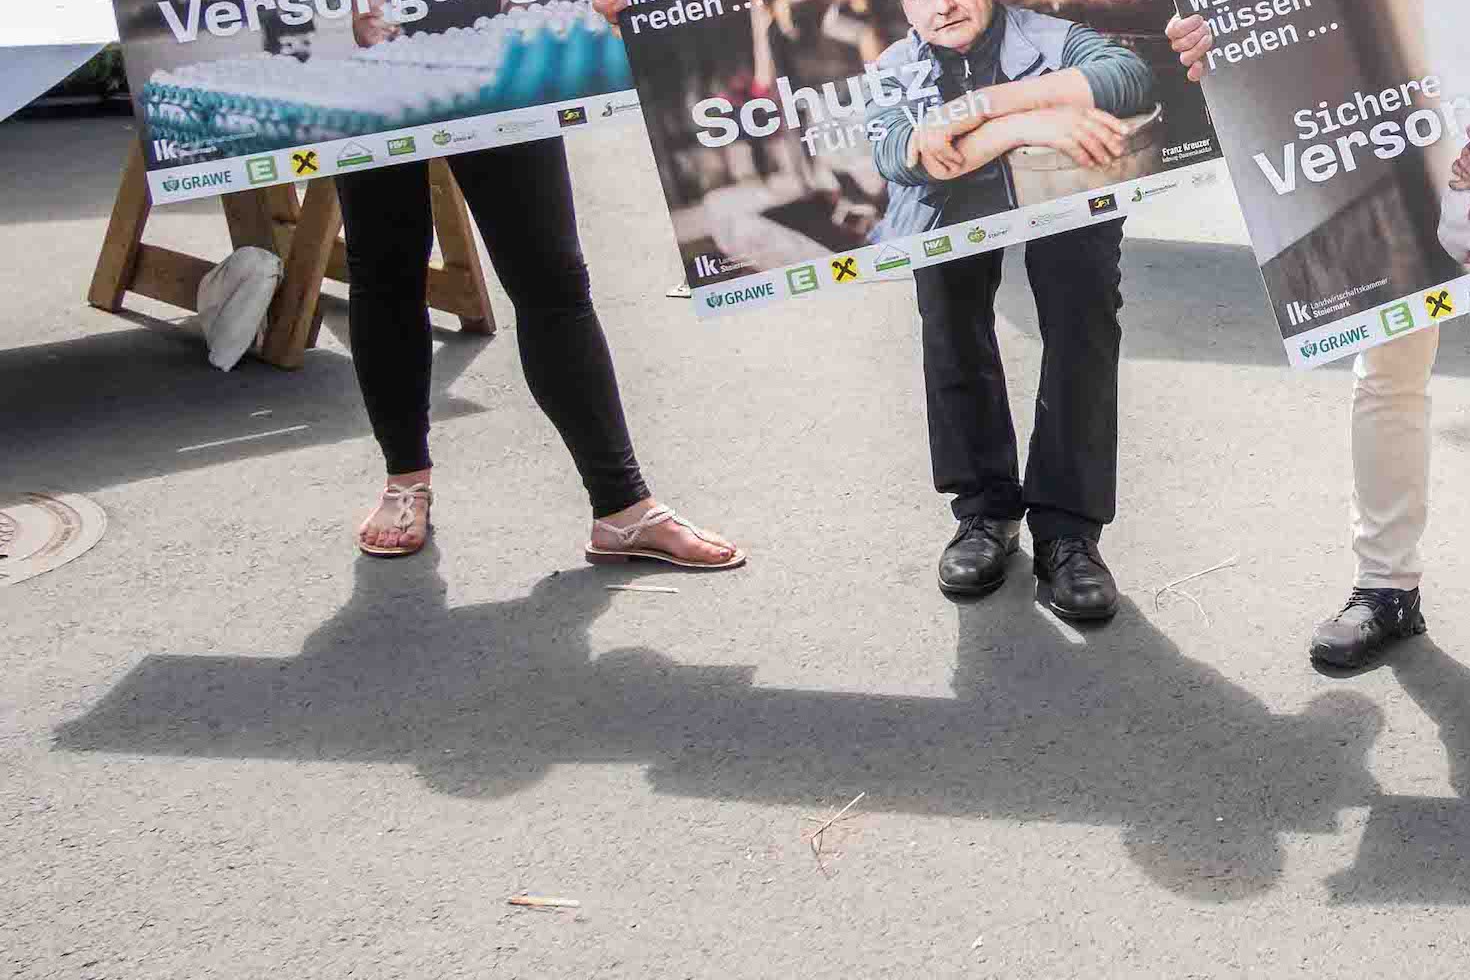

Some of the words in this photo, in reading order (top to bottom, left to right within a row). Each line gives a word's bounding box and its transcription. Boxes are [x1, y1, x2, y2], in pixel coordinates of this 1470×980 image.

[1206, 24, 1299, 70] reden
[691, 59, 940, 150] Schutz
[1293, 73, 1442, 140] Sichere
[801, 118, 888, 157] fürs
[901, 89, 992, 130] Vieh
[1161, 146, 1183, 157] Franz
[1183, 138, 1211, 152] Kreuzer
[182, 170, 232, 191] GRAWE
[695, 255, 720, 278] lk
[724, 282, 775, 305] GRAWE
[1311, 277, 1389, 310] Landwirtschaftskammer
[1286, 300, 1313, 326] lk
[1313, 300, 1351, 318] Steiermark
[1319, 324, 1370, 353] GRAWE
